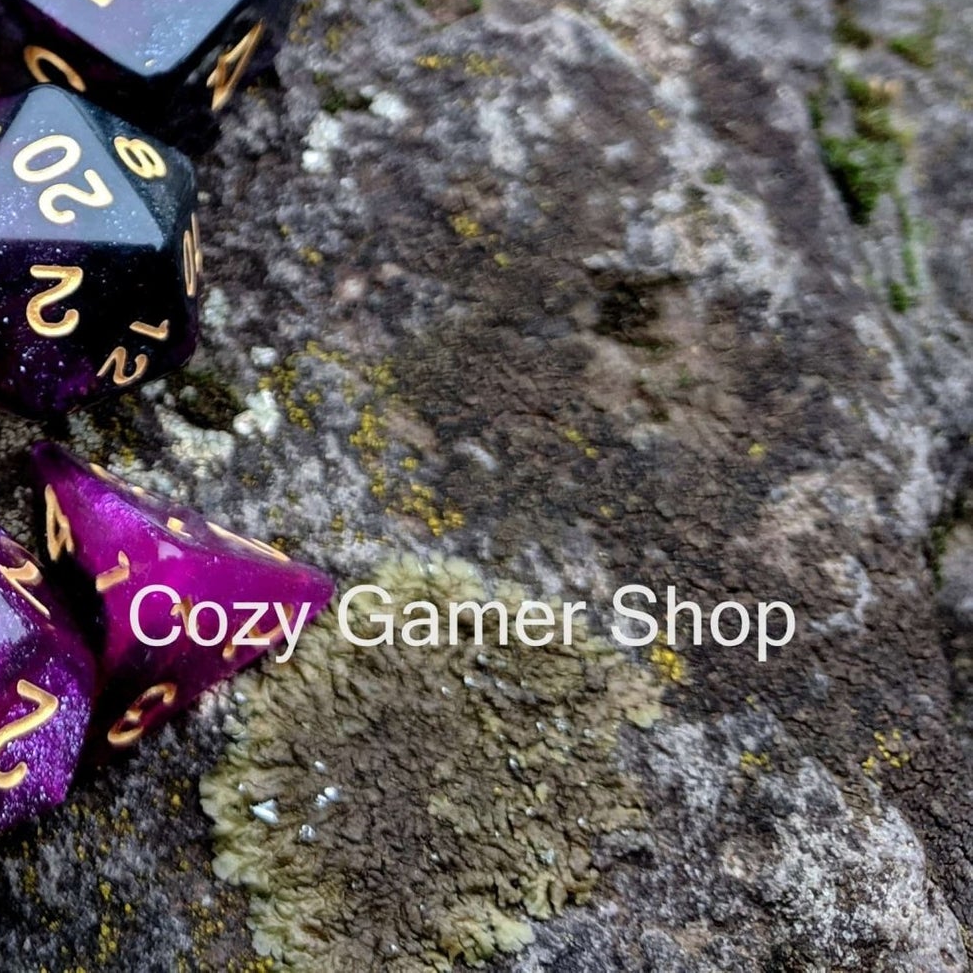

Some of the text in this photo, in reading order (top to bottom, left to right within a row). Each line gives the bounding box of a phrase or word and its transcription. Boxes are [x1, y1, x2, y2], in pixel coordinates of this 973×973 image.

[13, 134, 114, 224] 20
[26, 264, 84, 338] 2
[96, 318, 170, 386] 12
[44, 483, 75, 561] 4
